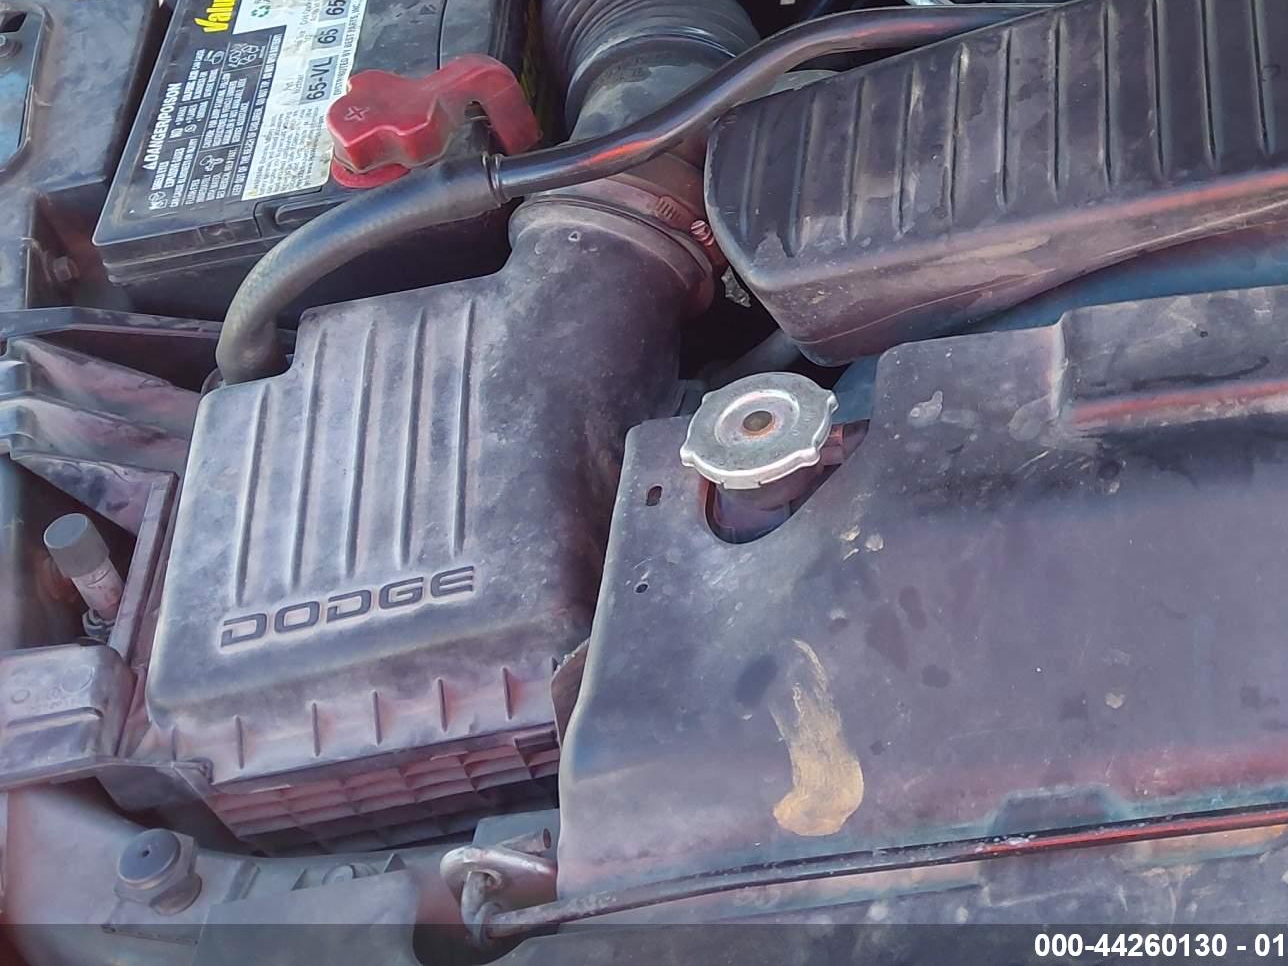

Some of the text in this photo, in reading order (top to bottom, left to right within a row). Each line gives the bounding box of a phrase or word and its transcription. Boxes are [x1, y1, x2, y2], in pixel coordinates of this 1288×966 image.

[317, 27, 338, 44] 65
[307, 57, 332, 101] 65-VL
[219, 564, 475, 648] DODGE
